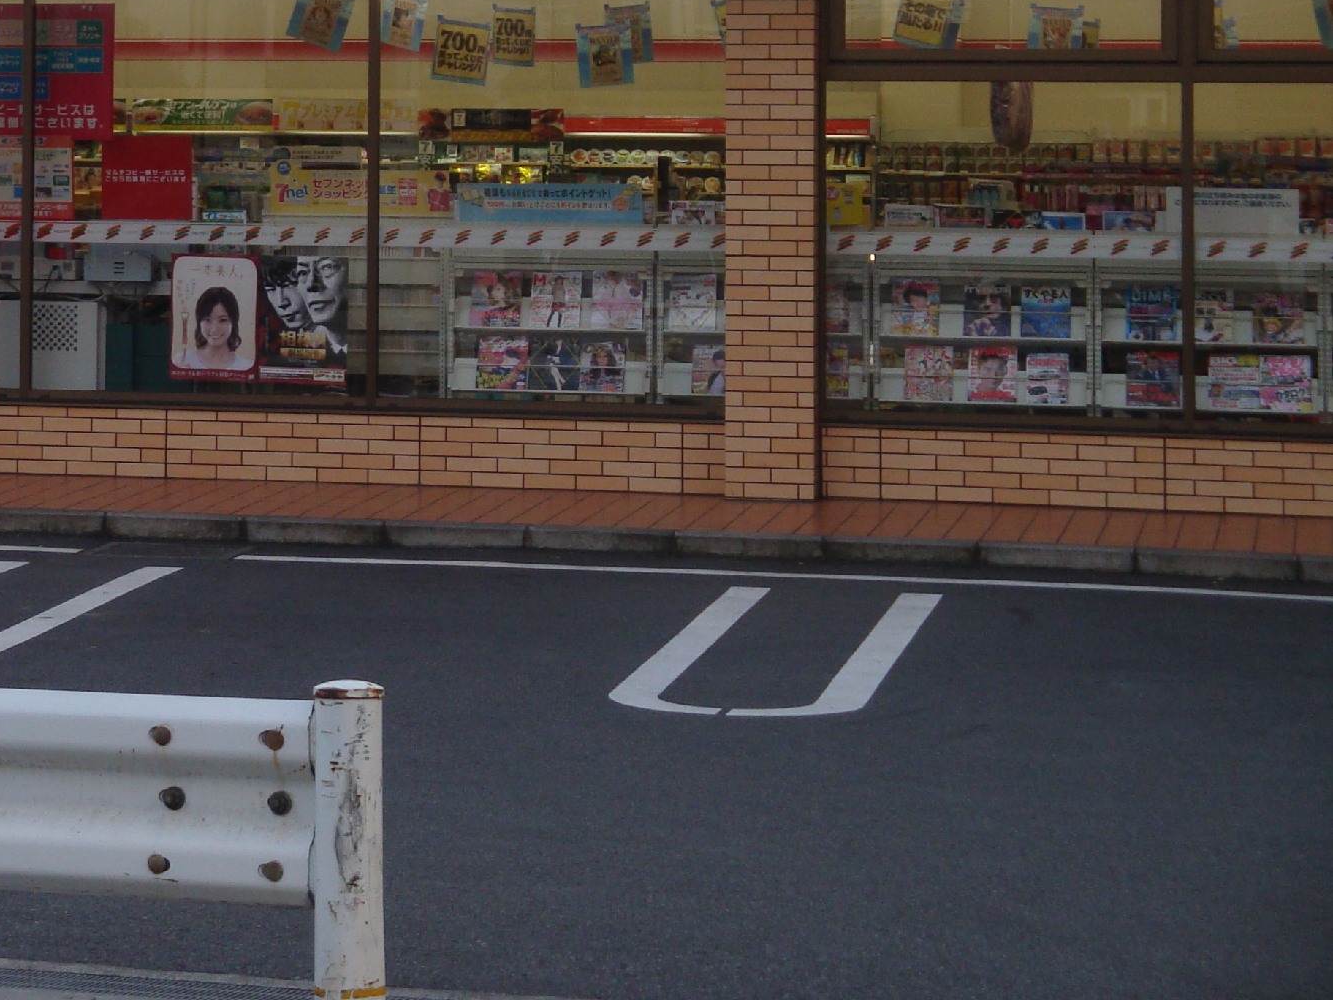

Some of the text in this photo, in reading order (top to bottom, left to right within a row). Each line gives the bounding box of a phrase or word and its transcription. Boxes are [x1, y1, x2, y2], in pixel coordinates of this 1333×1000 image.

[312, 177, 368, 188] セブンネッ
[274, 183, 309, 203] 7net
